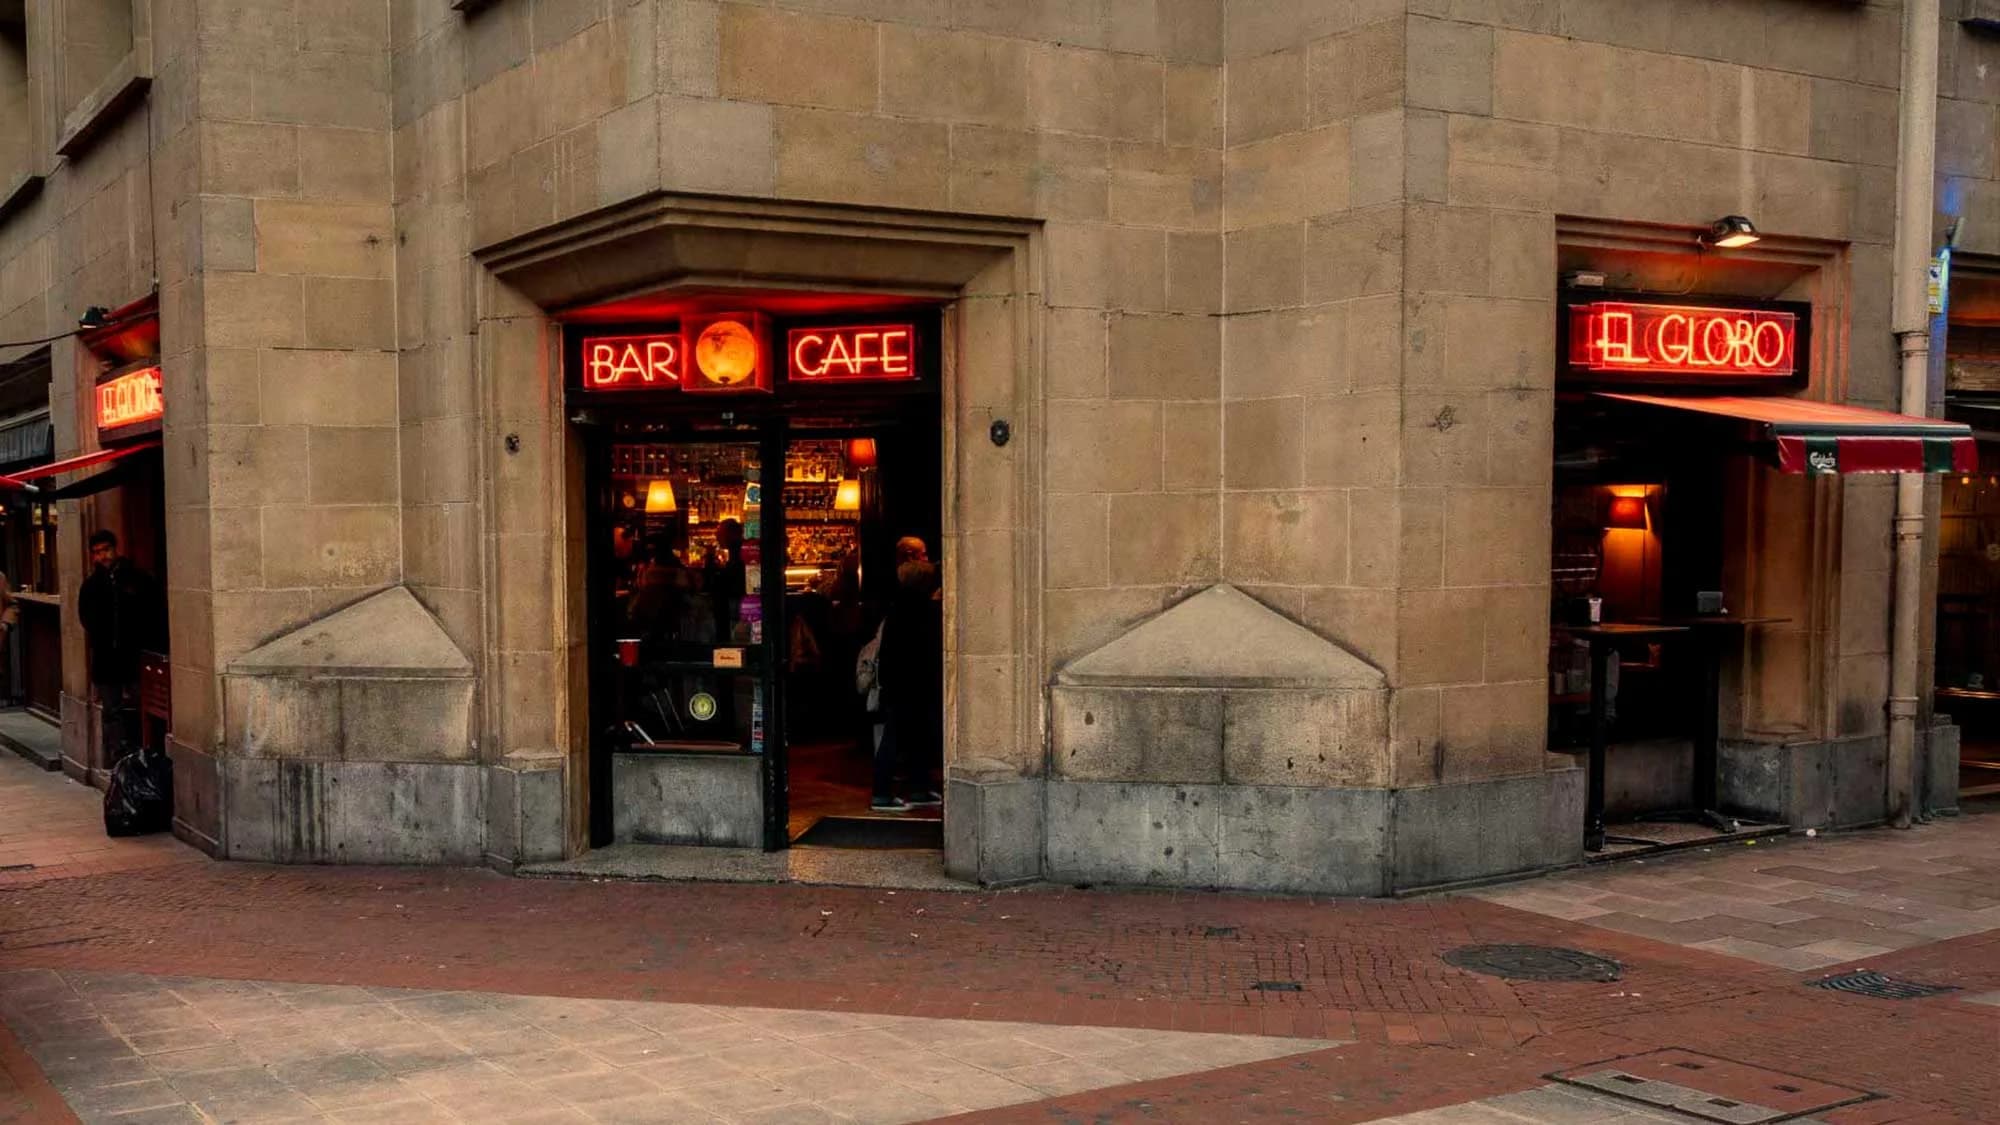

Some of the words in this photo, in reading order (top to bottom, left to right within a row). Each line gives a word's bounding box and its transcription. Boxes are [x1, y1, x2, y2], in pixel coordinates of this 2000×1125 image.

[589, 341, 678, 383] BAR
[795, 331, 907, 376] CAFE
[1596, 312, 1649, 362] EL
[1657, 313, 1784, 367] GLOBO
